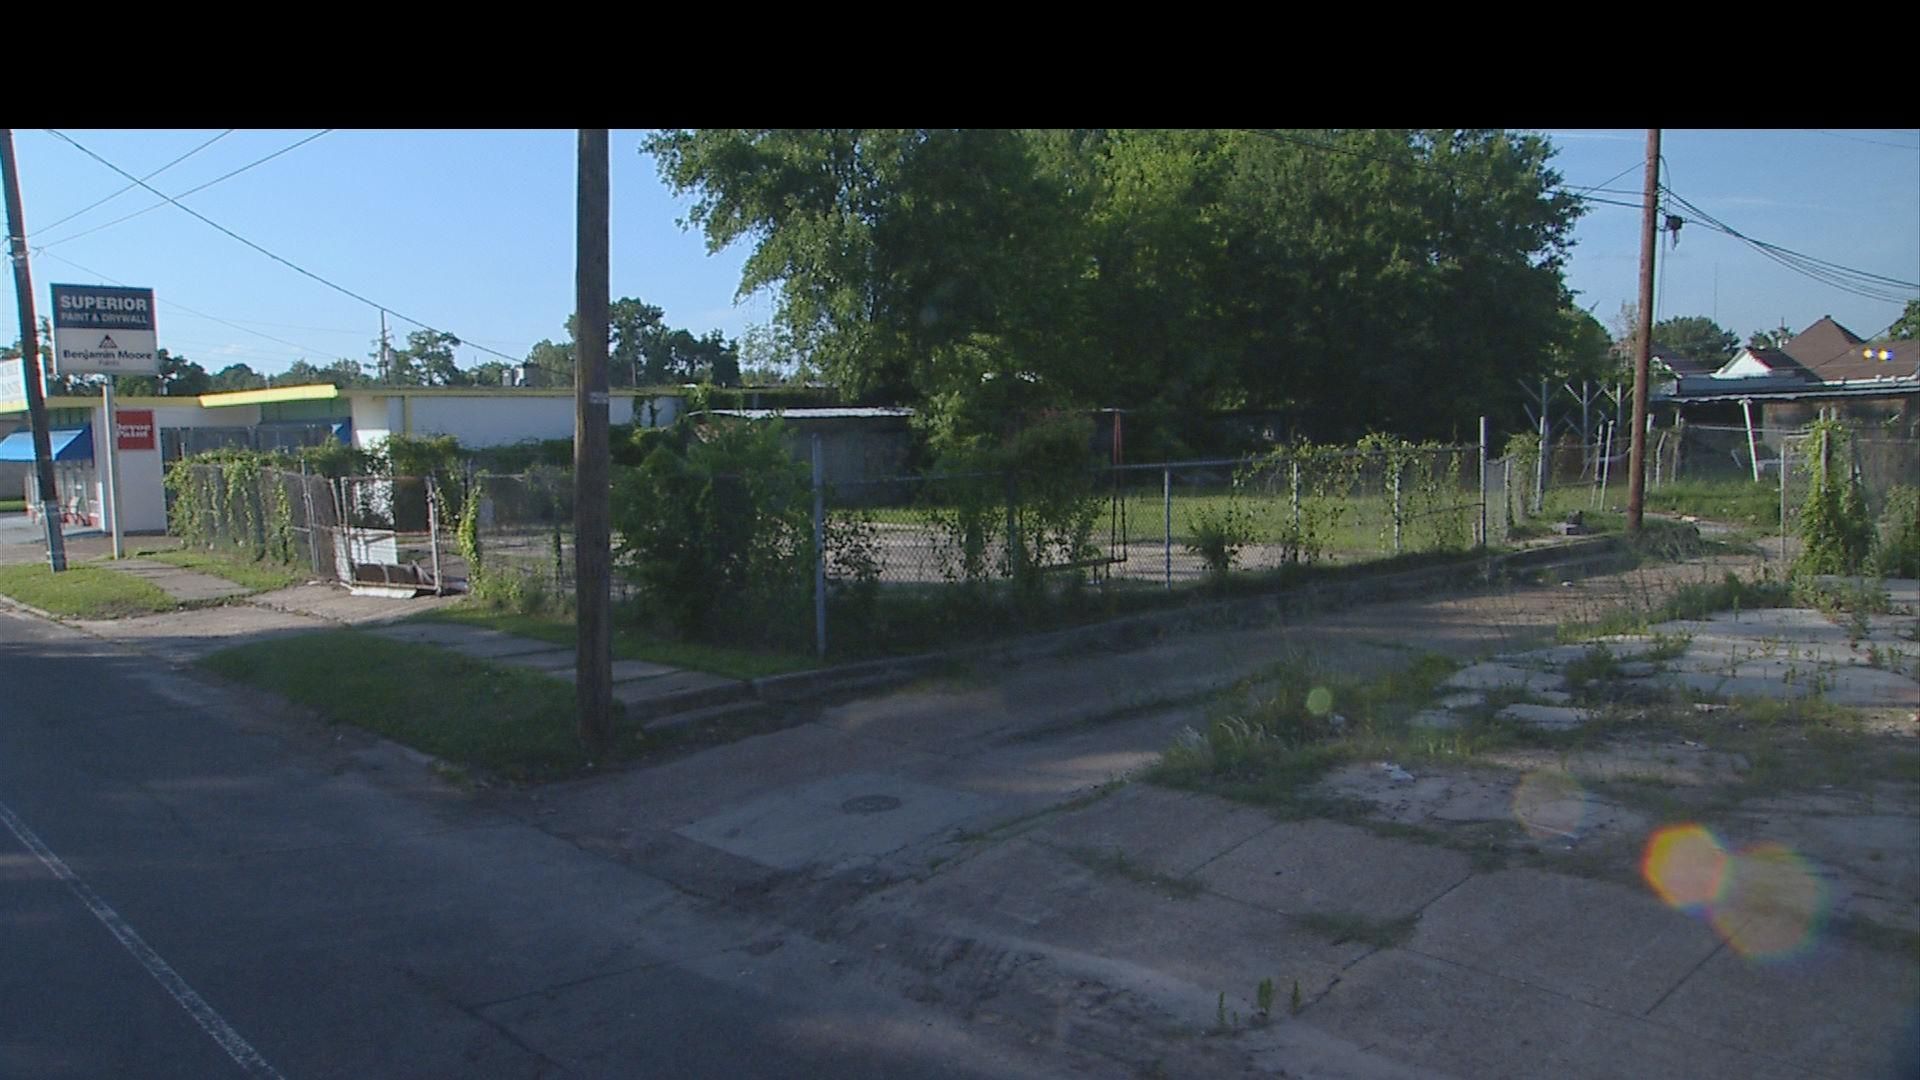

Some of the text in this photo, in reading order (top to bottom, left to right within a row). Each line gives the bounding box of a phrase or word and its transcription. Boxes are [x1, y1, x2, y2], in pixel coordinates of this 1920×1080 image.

[60, 295, 147, 311] SUPERIOR
[61, 312, 148, 324] PAINT & DRYWALL
[63, 349, 153, 360] Benjamin Moore
